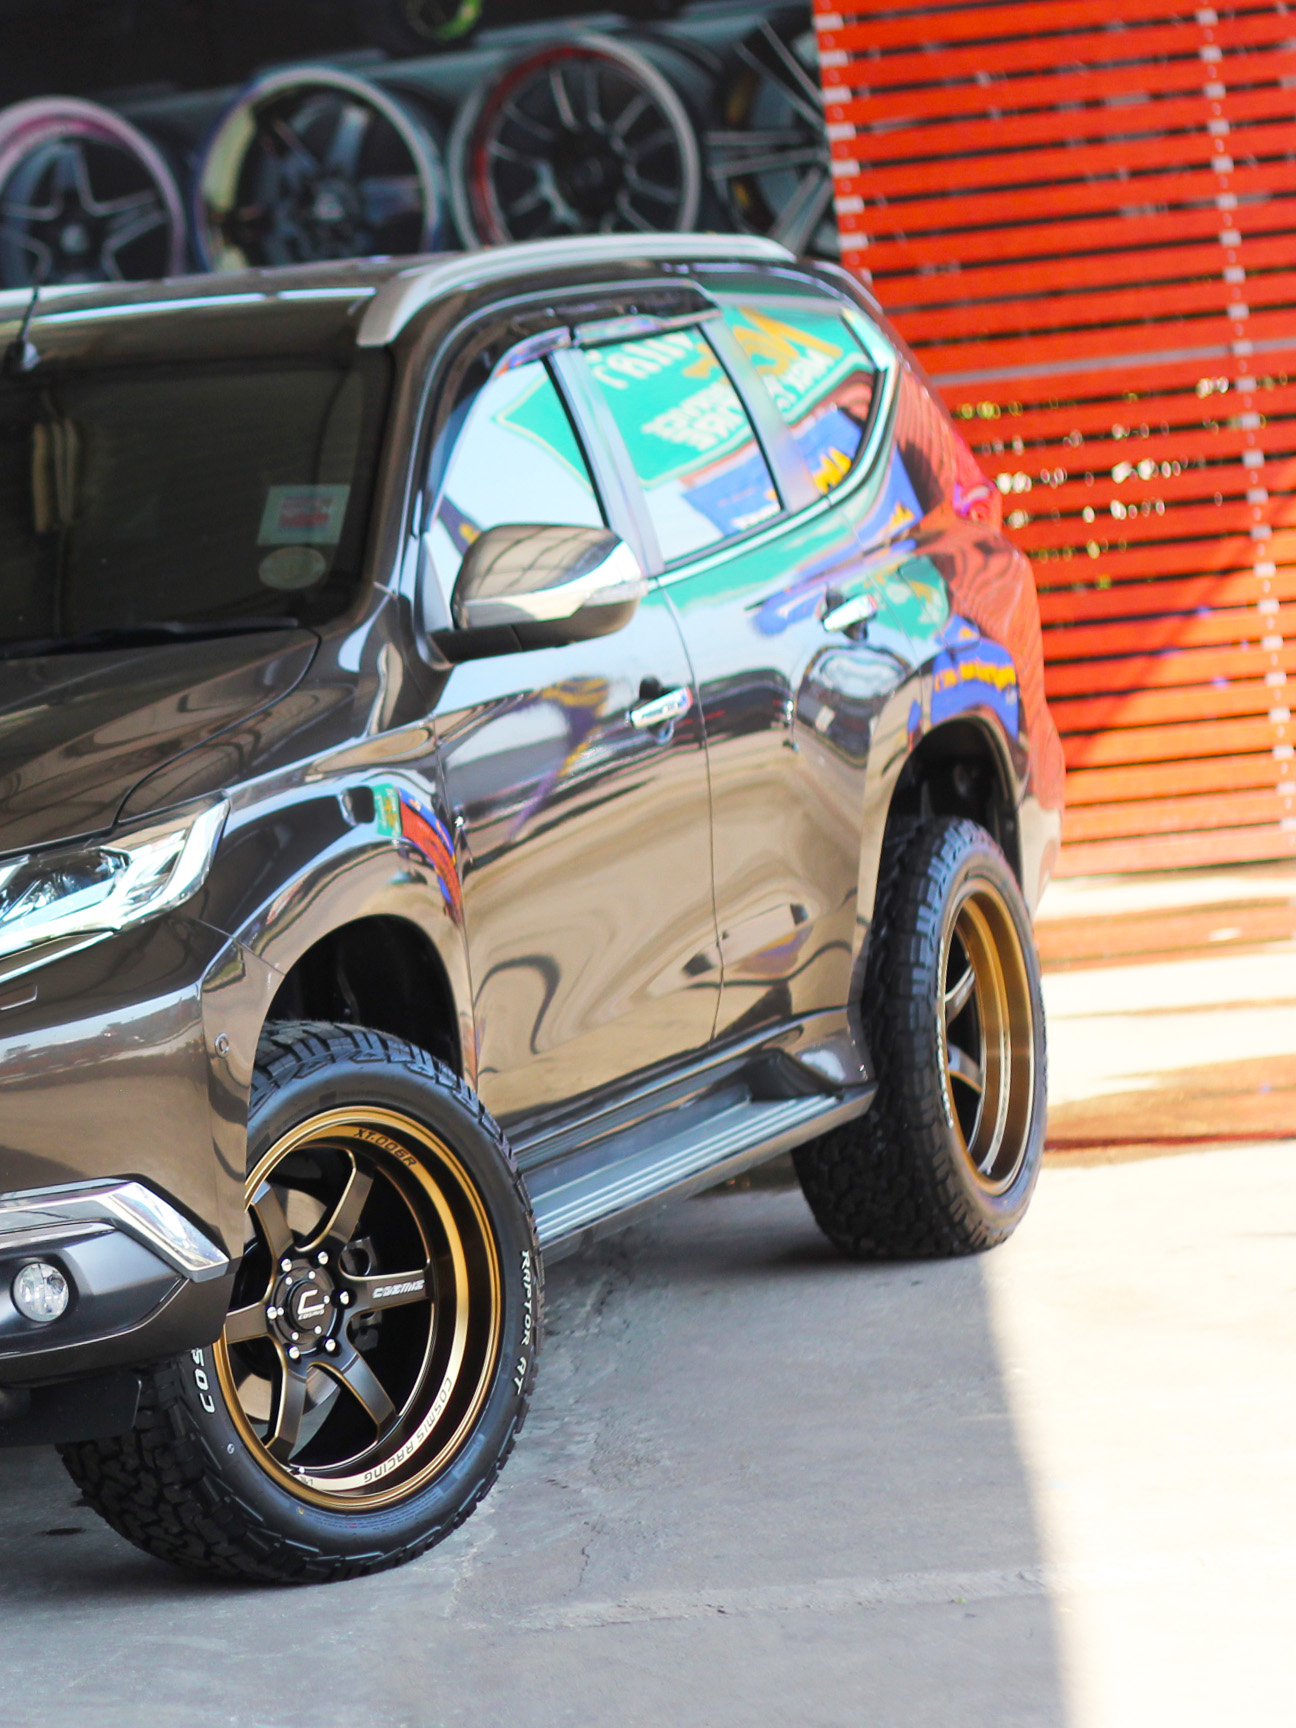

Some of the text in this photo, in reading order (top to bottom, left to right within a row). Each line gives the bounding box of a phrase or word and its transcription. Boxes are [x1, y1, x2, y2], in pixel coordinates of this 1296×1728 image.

[521, 1250, 533, 1346] RAPTOR
[363, 1376, 453, 1483] COSMIS RACING
